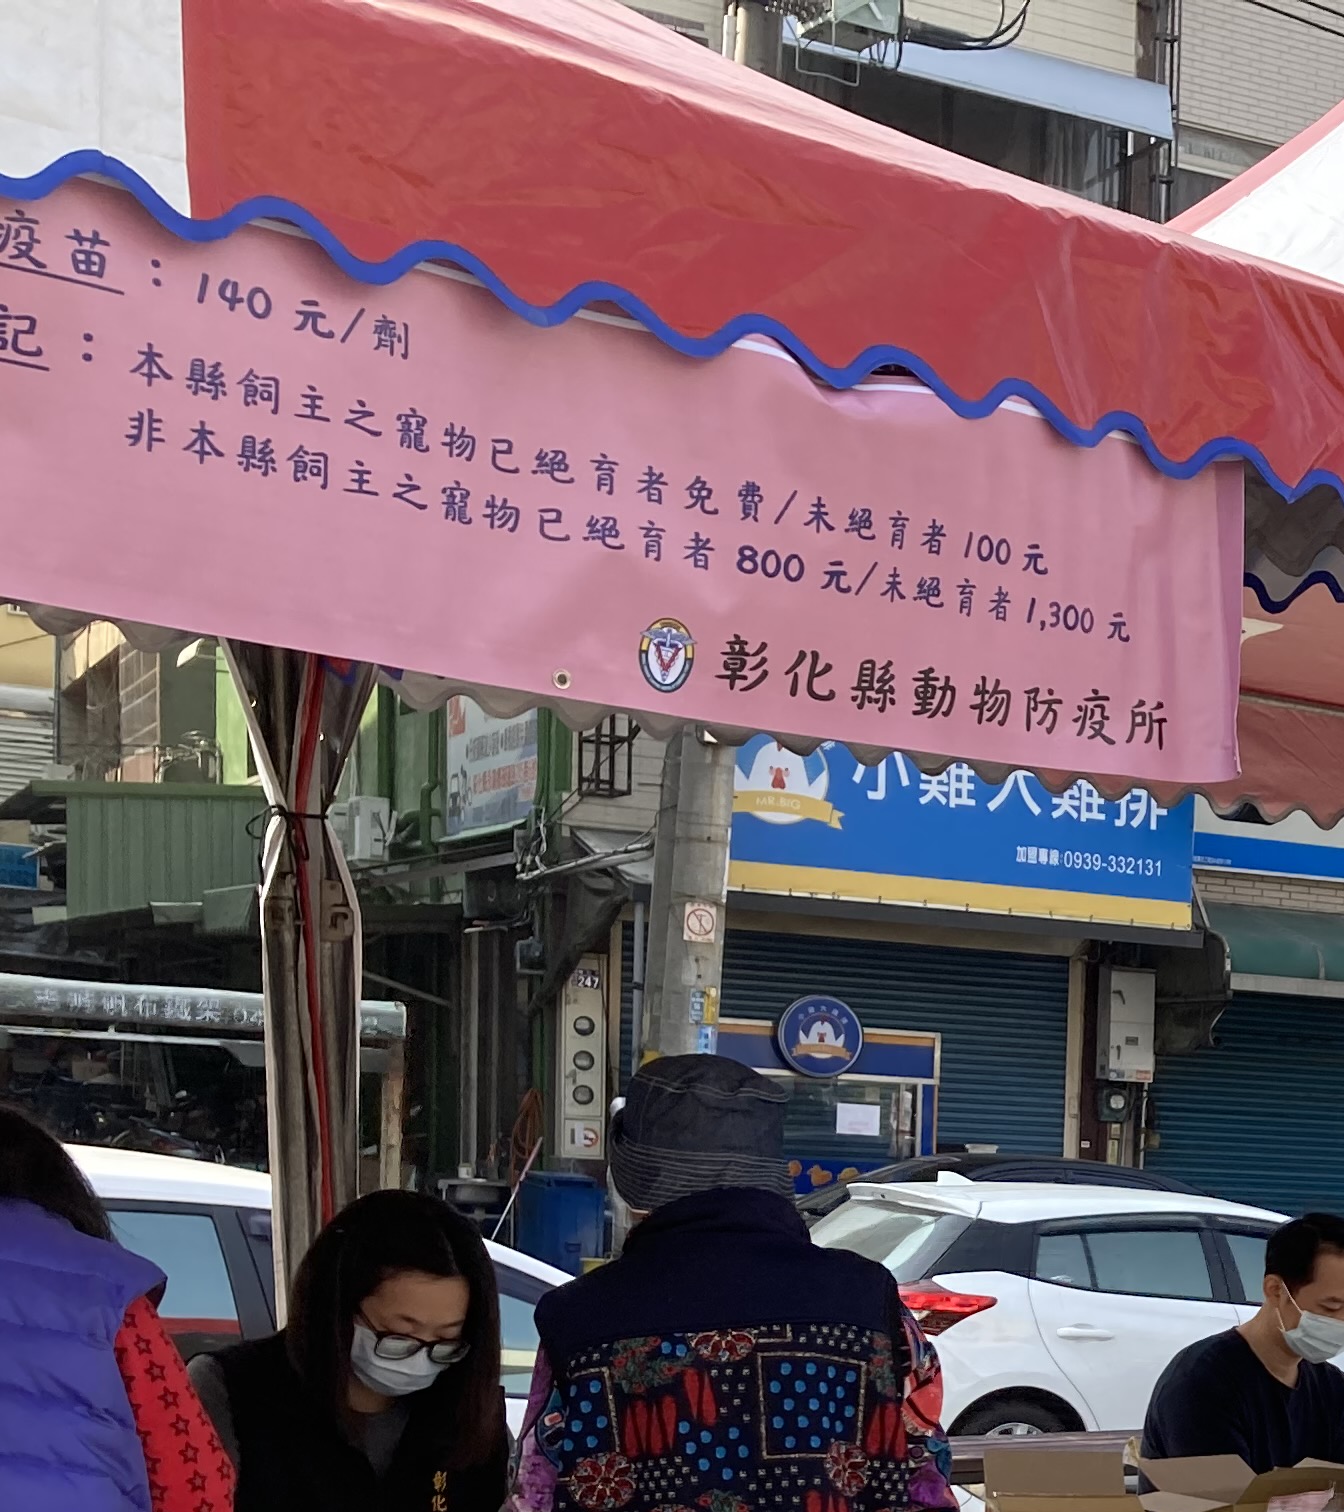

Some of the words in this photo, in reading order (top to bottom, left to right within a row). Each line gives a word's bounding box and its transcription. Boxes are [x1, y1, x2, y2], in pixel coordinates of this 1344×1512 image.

[715, 634, 1168, 750] 彰化縣動物防疫所
[577, 975, 599, 989] 247
